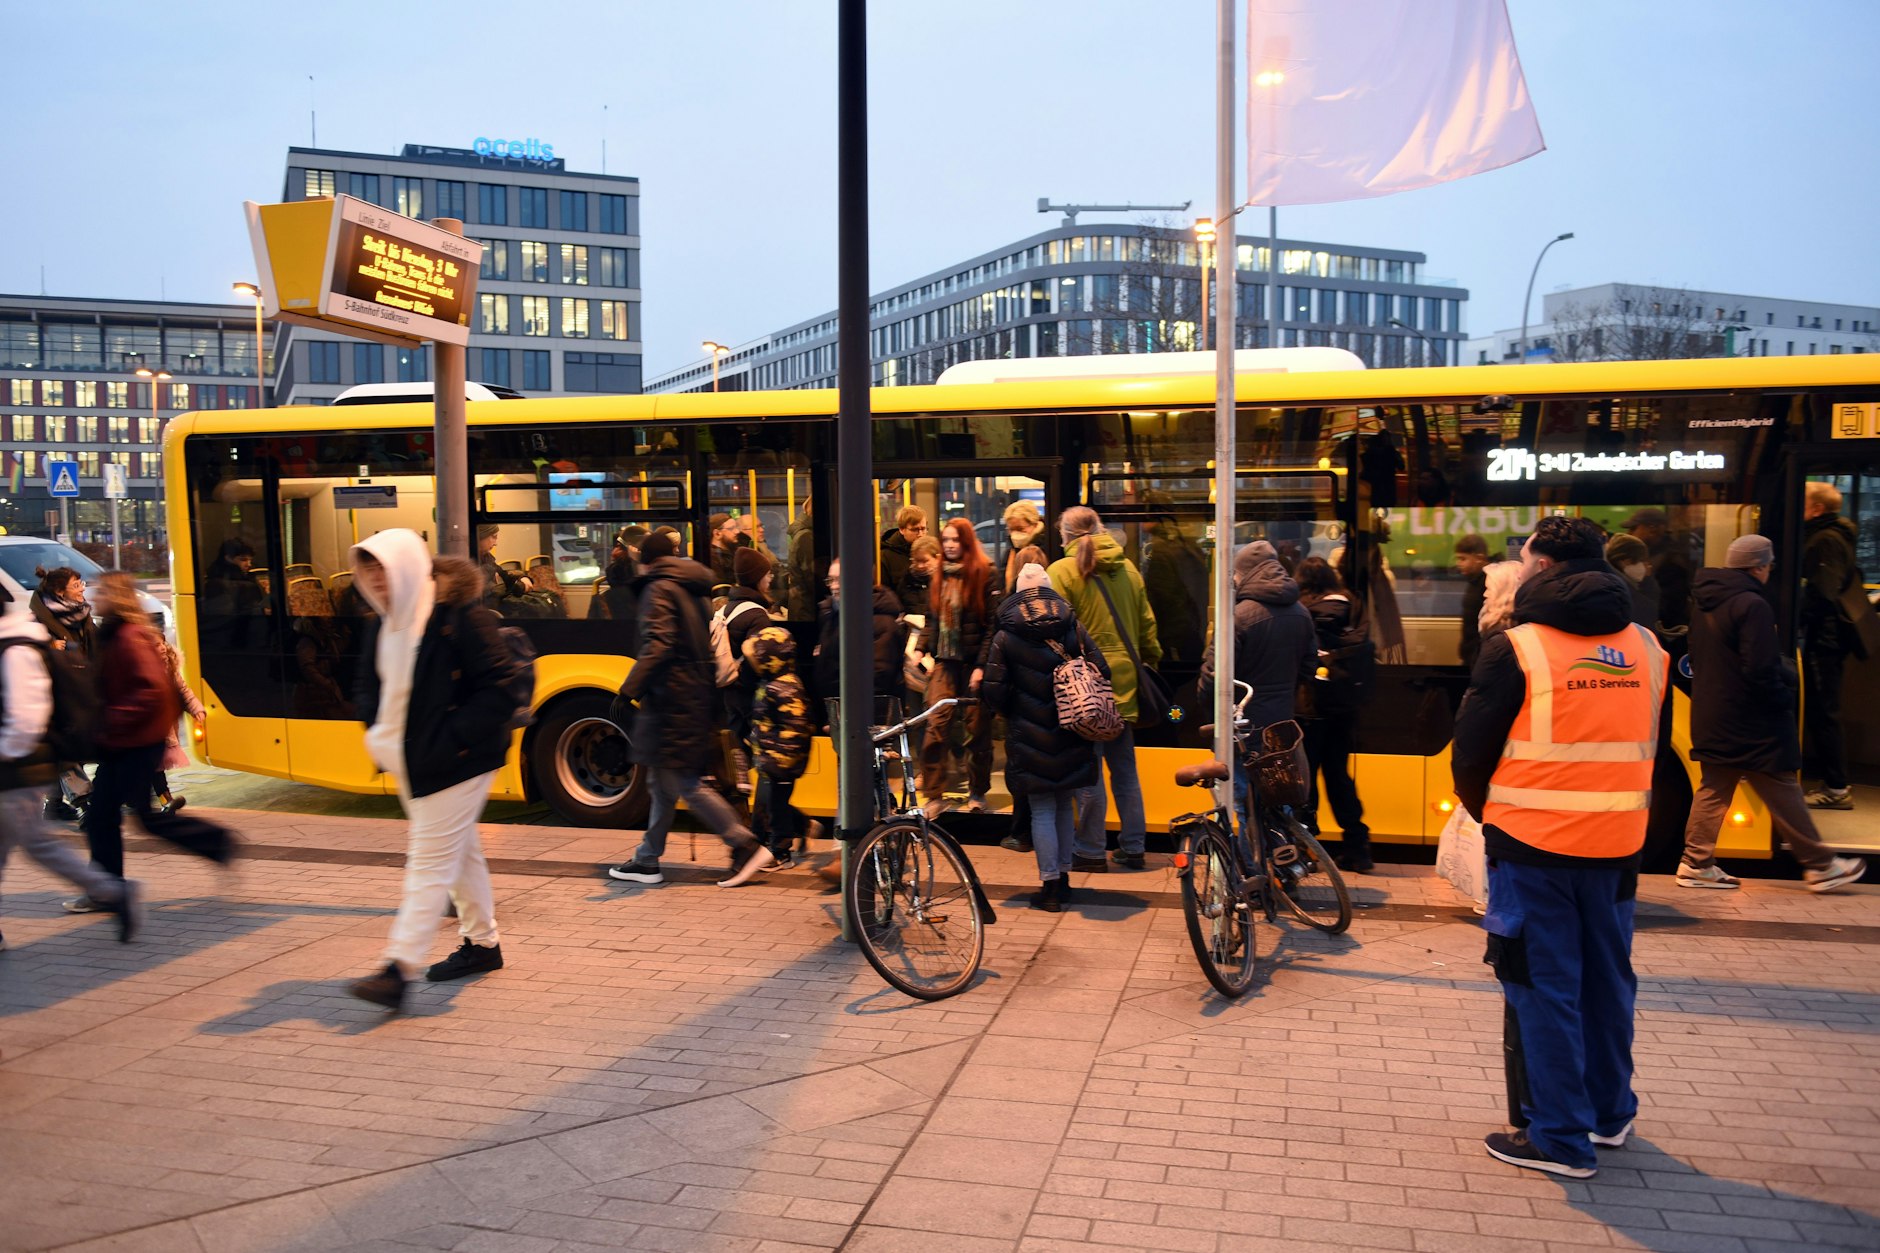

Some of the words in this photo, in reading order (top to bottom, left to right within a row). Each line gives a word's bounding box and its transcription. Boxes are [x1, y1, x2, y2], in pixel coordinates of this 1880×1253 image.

[359, 212, 374, 227] Linie
[436, 259, 443, 272] 3
[345, 300, 380, 317] S-Bahnhof
[380, 309, 409, 324] Südkreuz
[1688, 418, 1775, 428] EfficientHybrid
[1486, 448, 1537, 481] 204
[1571, 452, 1668, 473] Zoologischer
[1669, 451, 1725, 470] Garten
[1599, 678, 1640, 688] Services
